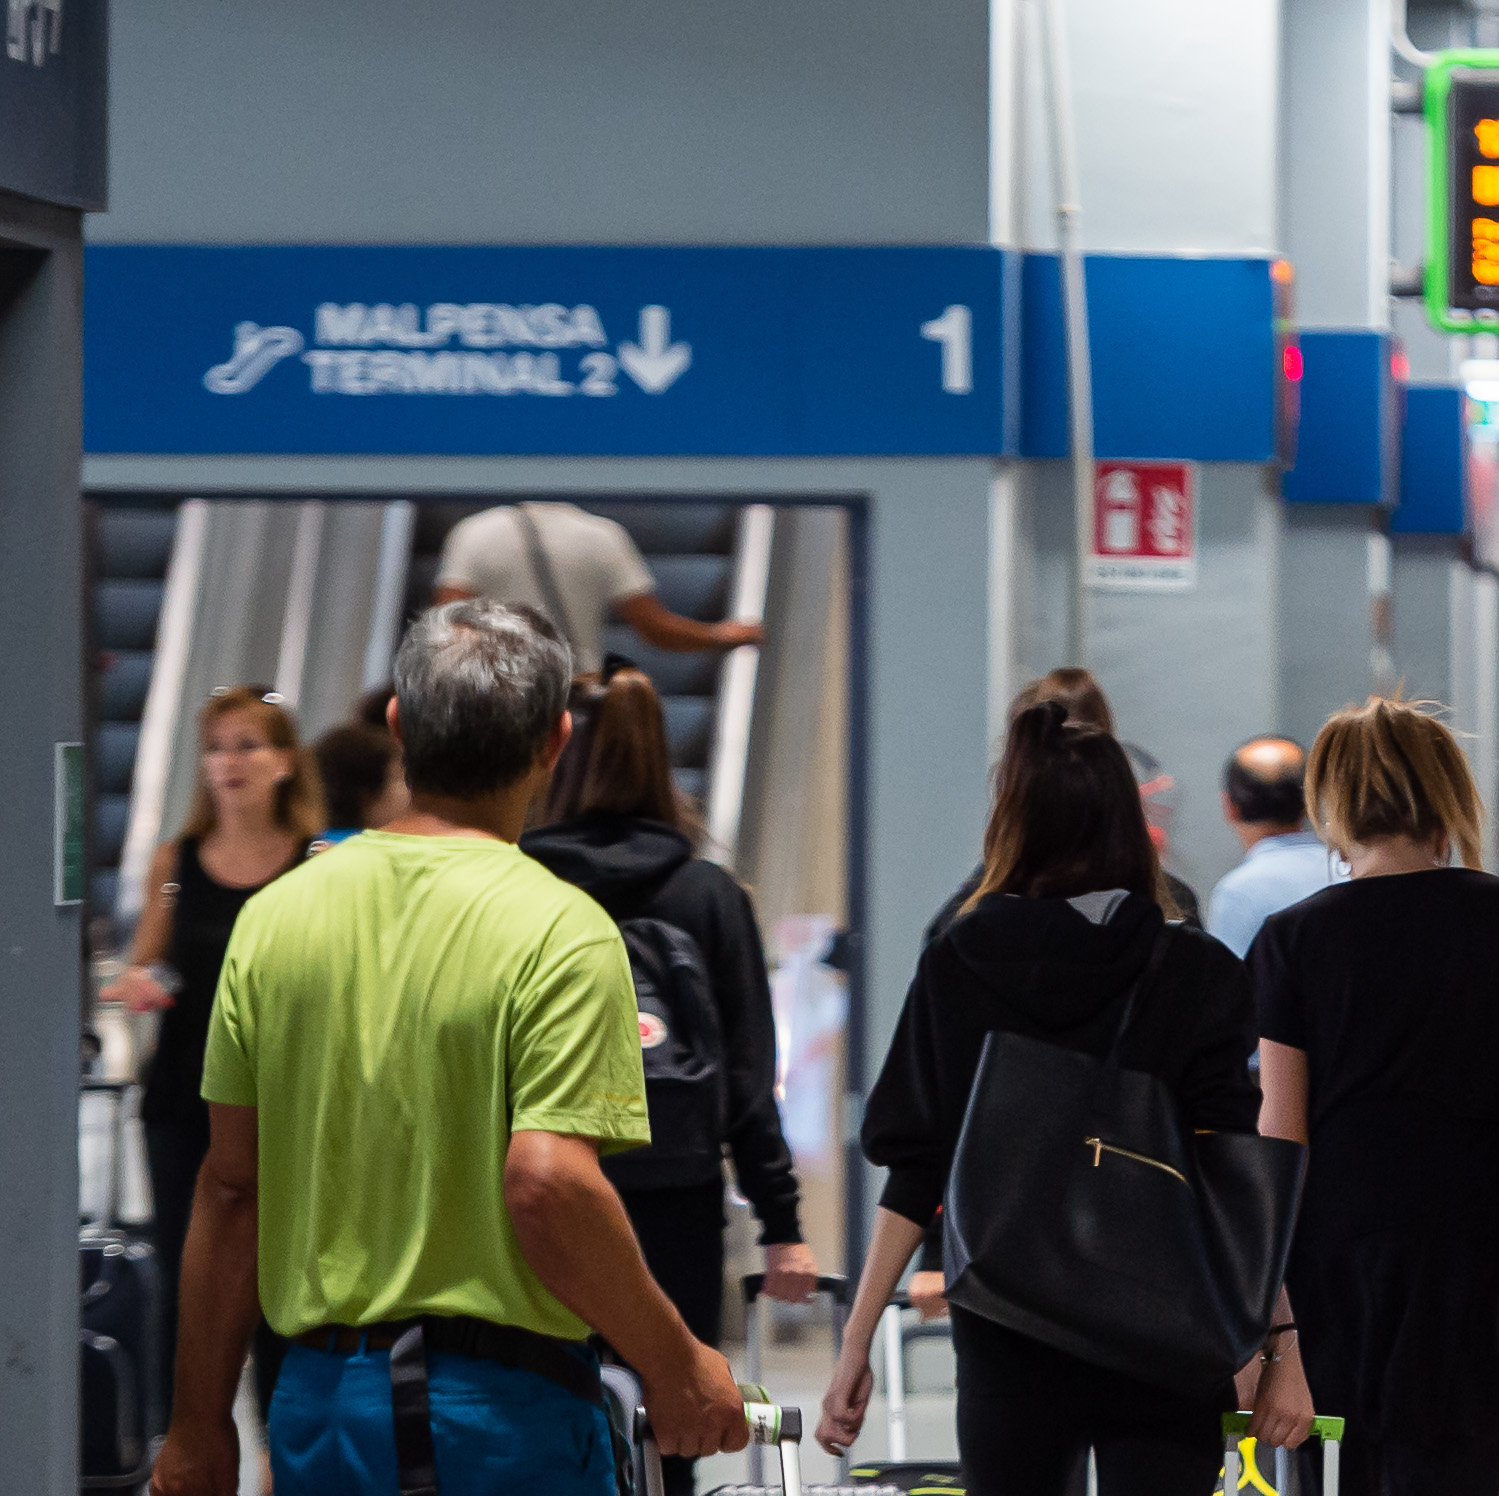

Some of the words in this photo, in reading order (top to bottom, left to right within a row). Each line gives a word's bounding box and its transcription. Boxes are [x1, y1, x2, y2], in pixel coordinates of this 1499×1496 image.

[314, 302, 608, 348] MALPENSA
[920, 304, 974, 395] 1
[301, 350, 576, 397] TERMINAL
[578, 352, 619, 398] 2
